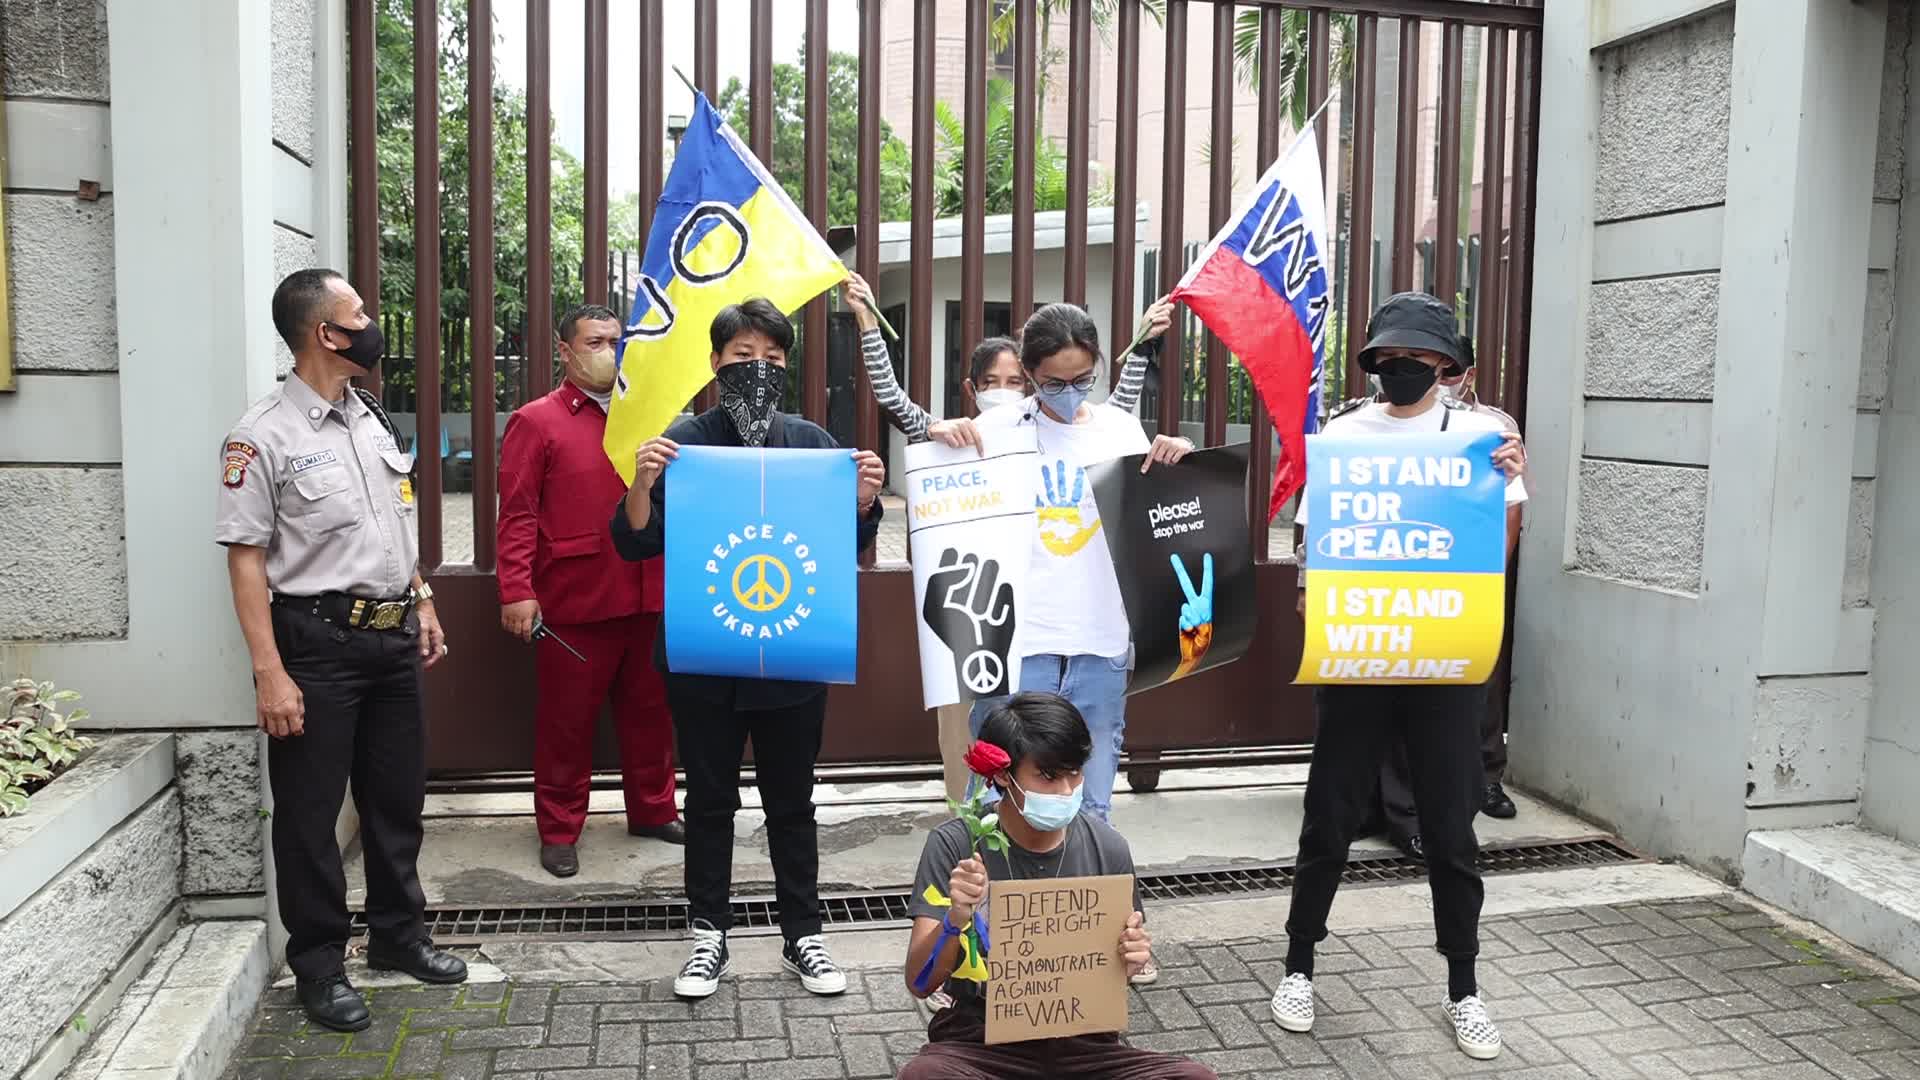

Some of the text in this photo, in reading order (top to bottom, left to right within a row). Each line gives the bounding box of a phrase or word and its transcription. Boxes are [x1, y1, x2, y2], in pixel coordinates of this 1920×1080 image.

[921, 470, 987, 493] PEACE,
[1330, 456, 1472, 487] I STAND
[914, 490, 1003, 520] NOT WAR
[1148, 496, 1202, 528] please!
[1330, 491, 1402, 521] FOR
[1153, 519, 1205, 539] stop the war
[1329, 527, 1450, 560] PEACE
[705, 524, 817, 575] PEACE FOR
[1326, 587, 1464, 618] I STAND
[711, 602, 812, 640] UKRAINE
[1324, 624, 1413, 653] WITH
[1318, 658, 1472, 679] UKRAINE
[1000, 889, 1099, 922] DEFEND
[989, 952, 1109, 981] DEMONSTRATE
[994, 977, 1064, 1001] AGAINST
